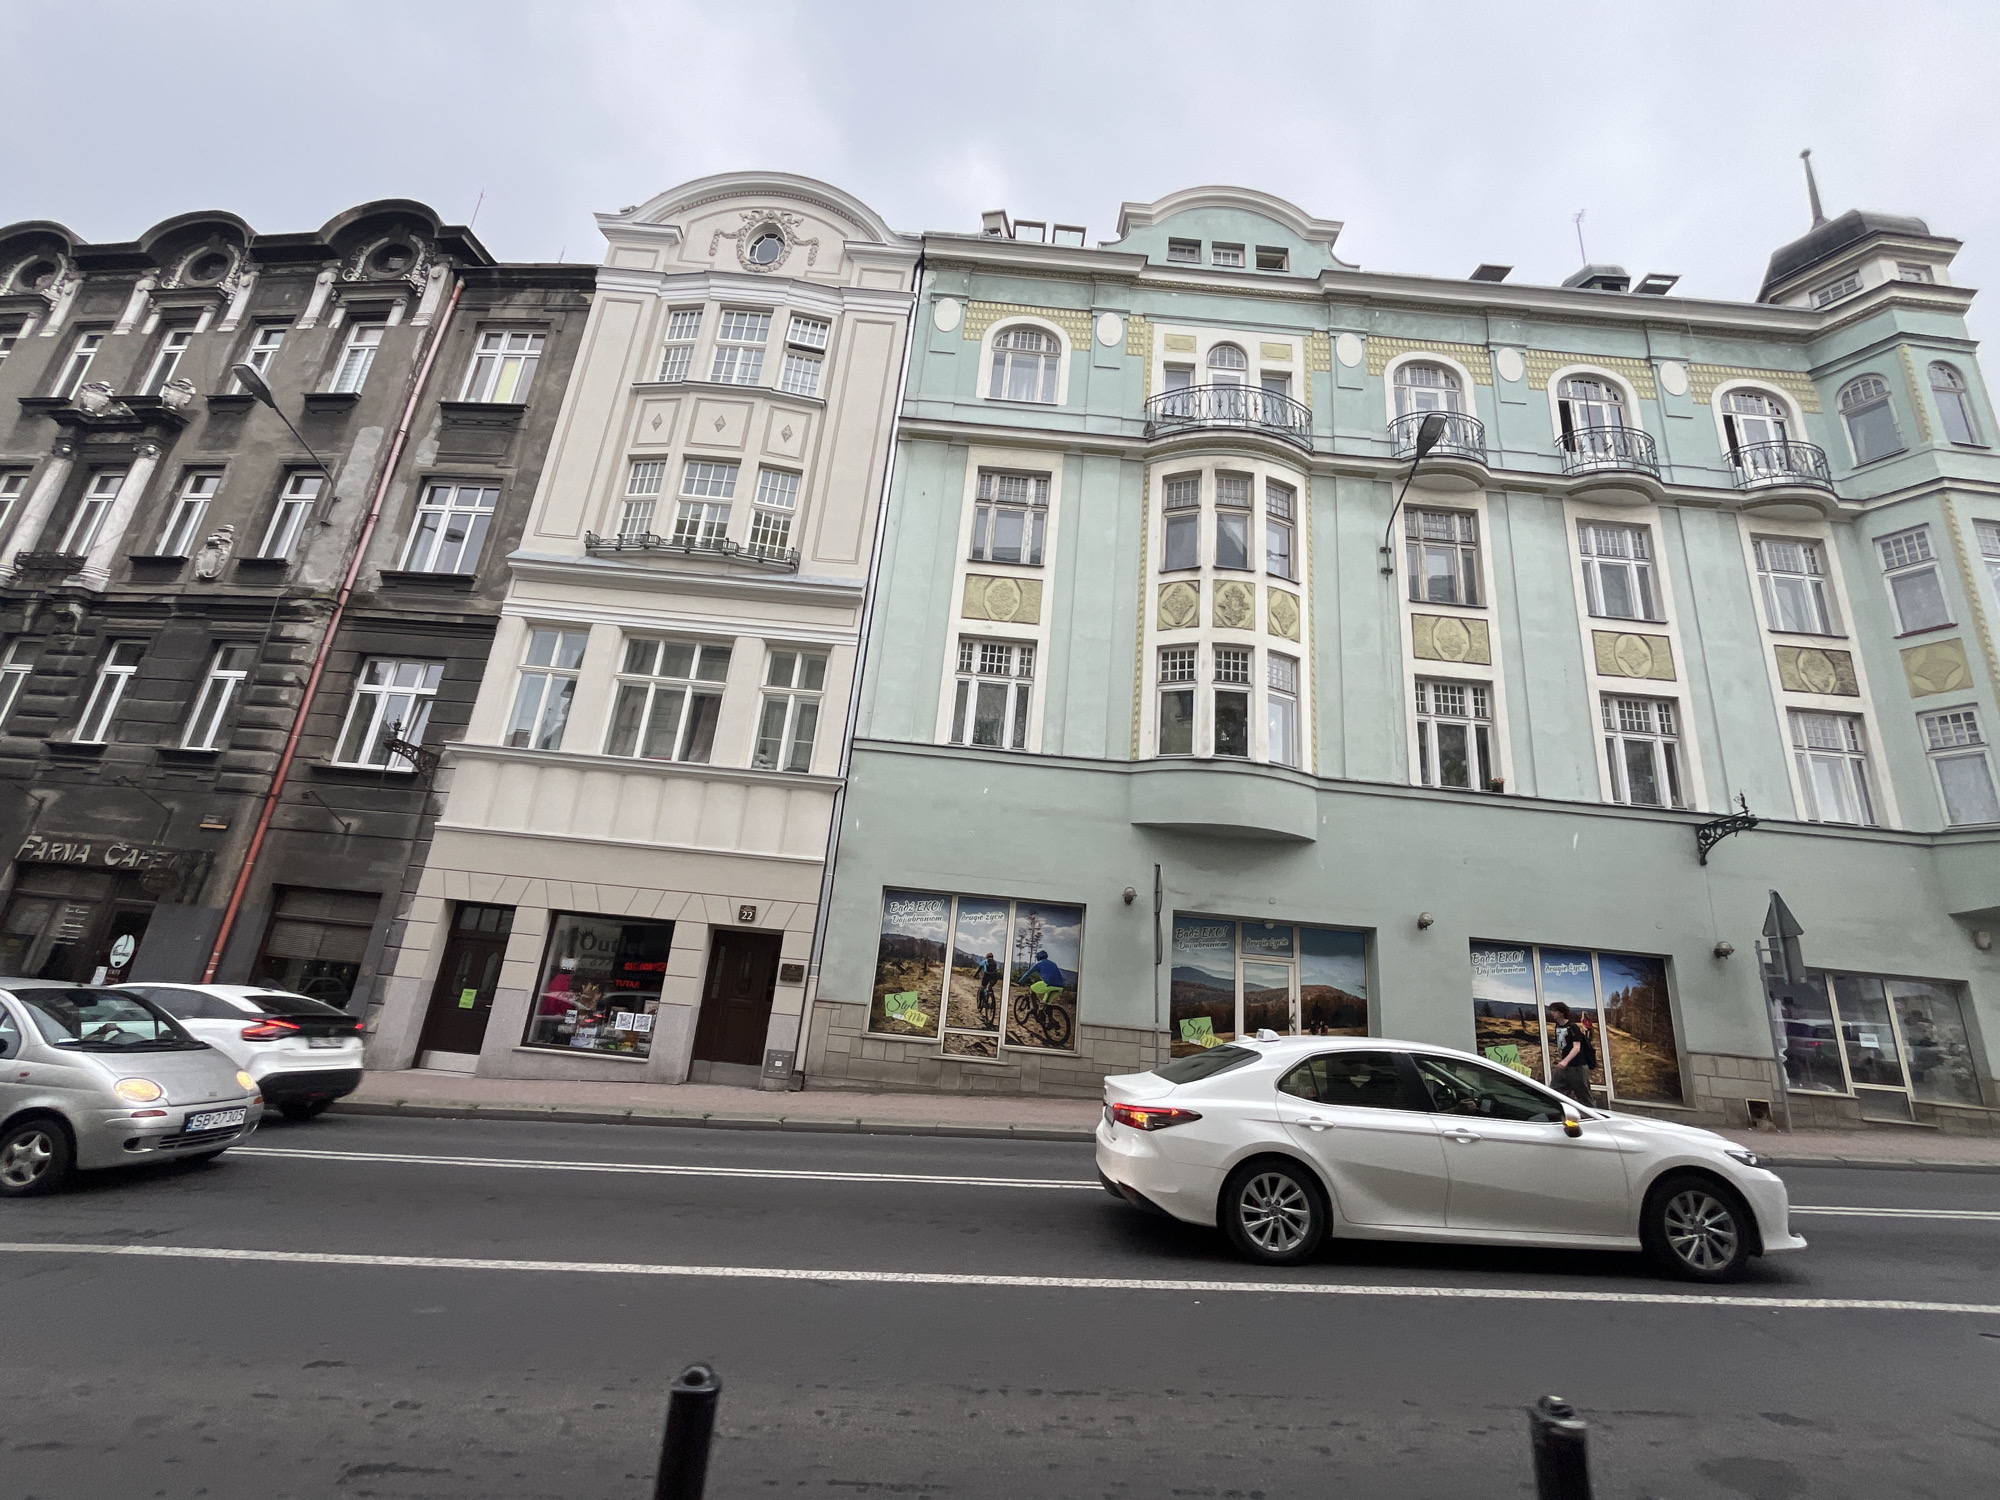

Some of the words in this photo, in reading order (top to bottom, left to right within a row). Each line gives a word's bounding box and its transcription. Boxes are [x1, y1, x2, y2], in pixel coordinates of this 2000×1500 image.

[916, 900, 944, 912] EKO!
[741, 911, 753, 919] 22
[892, 915, 905, 926] Daj
[961, 912, 984, 925] drugie
[985, 911, 1004, 924] życie
[1202, 926, 1228, 938] EKO!
[1498, 951, 1525, 963] EKO!
[886, 993, 917, 1014] Styl
[1182, 1019, 1212, 1038] Styl
[195, 1115, 211, 1126] SB
[213, 1110, 245, 1124] 27305
